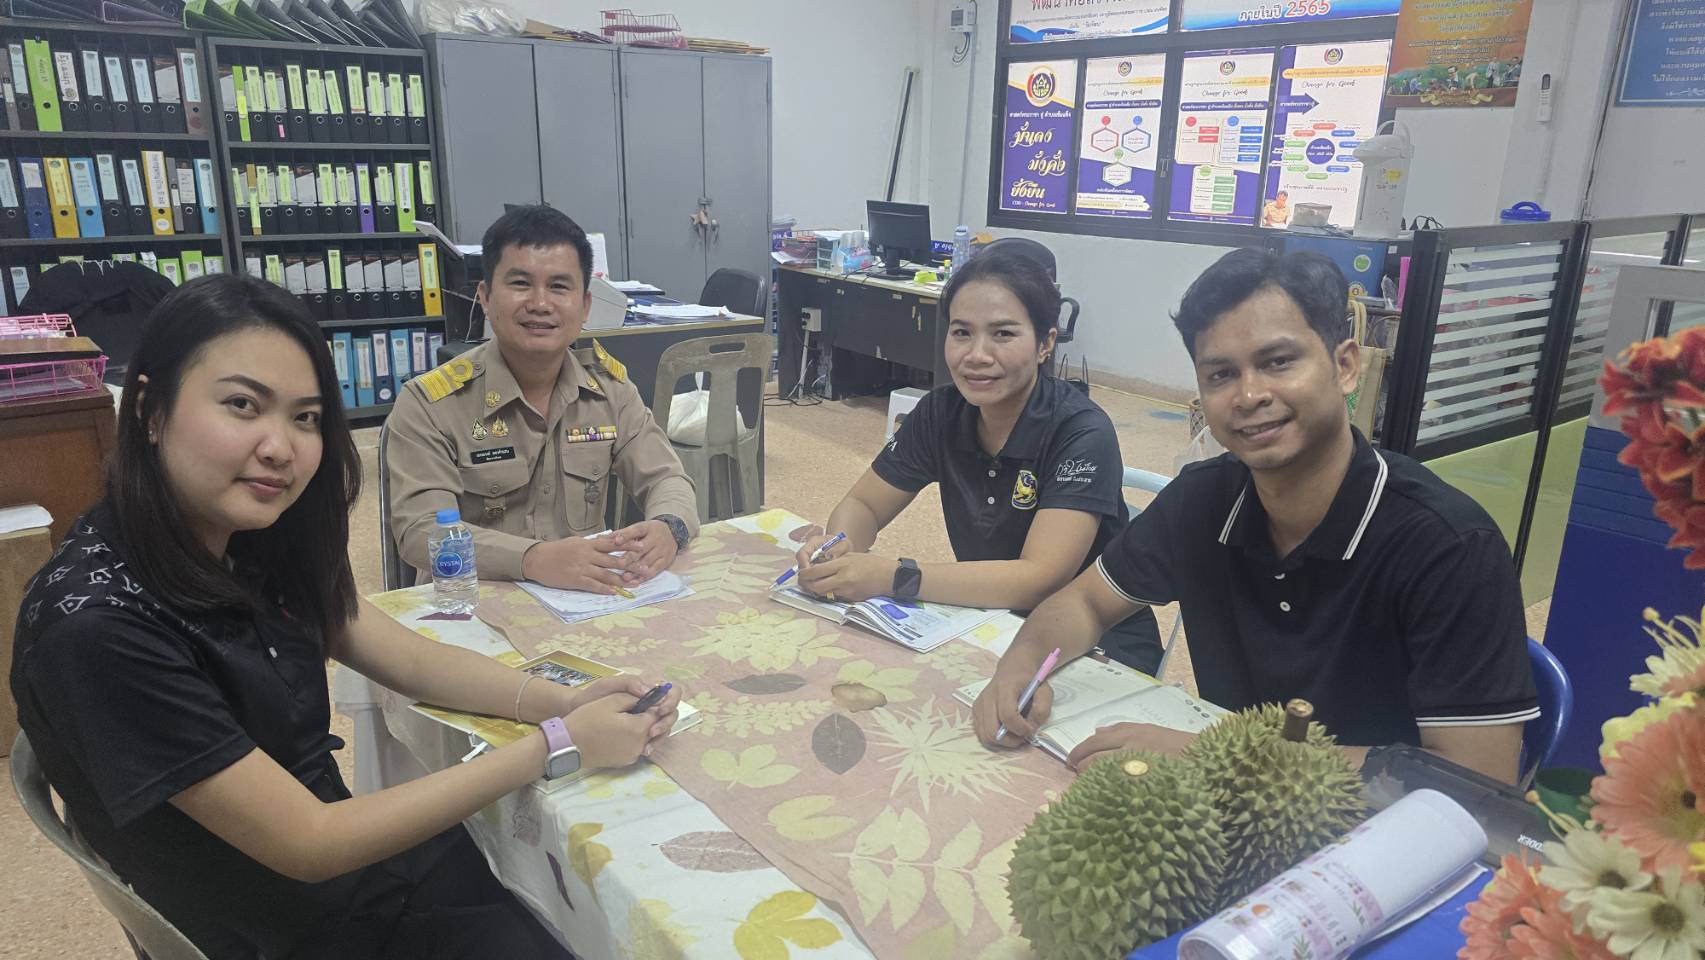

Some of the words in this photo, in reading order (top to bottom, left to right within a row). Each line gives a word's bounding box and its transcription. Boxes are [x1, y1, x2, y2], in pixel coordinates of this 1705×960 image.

[1239, 5, 1280, 20] ภายในปี
[1286, 0, 1329, 17] 2565
[1009, 121, 1056, 148] มั่นคง
[1027, 149, 1066, 176] มั่งคั่ง
[1010, 178, 1046, 199] ยั่งยืน
[1517, 834, 1543, 852] DDER
